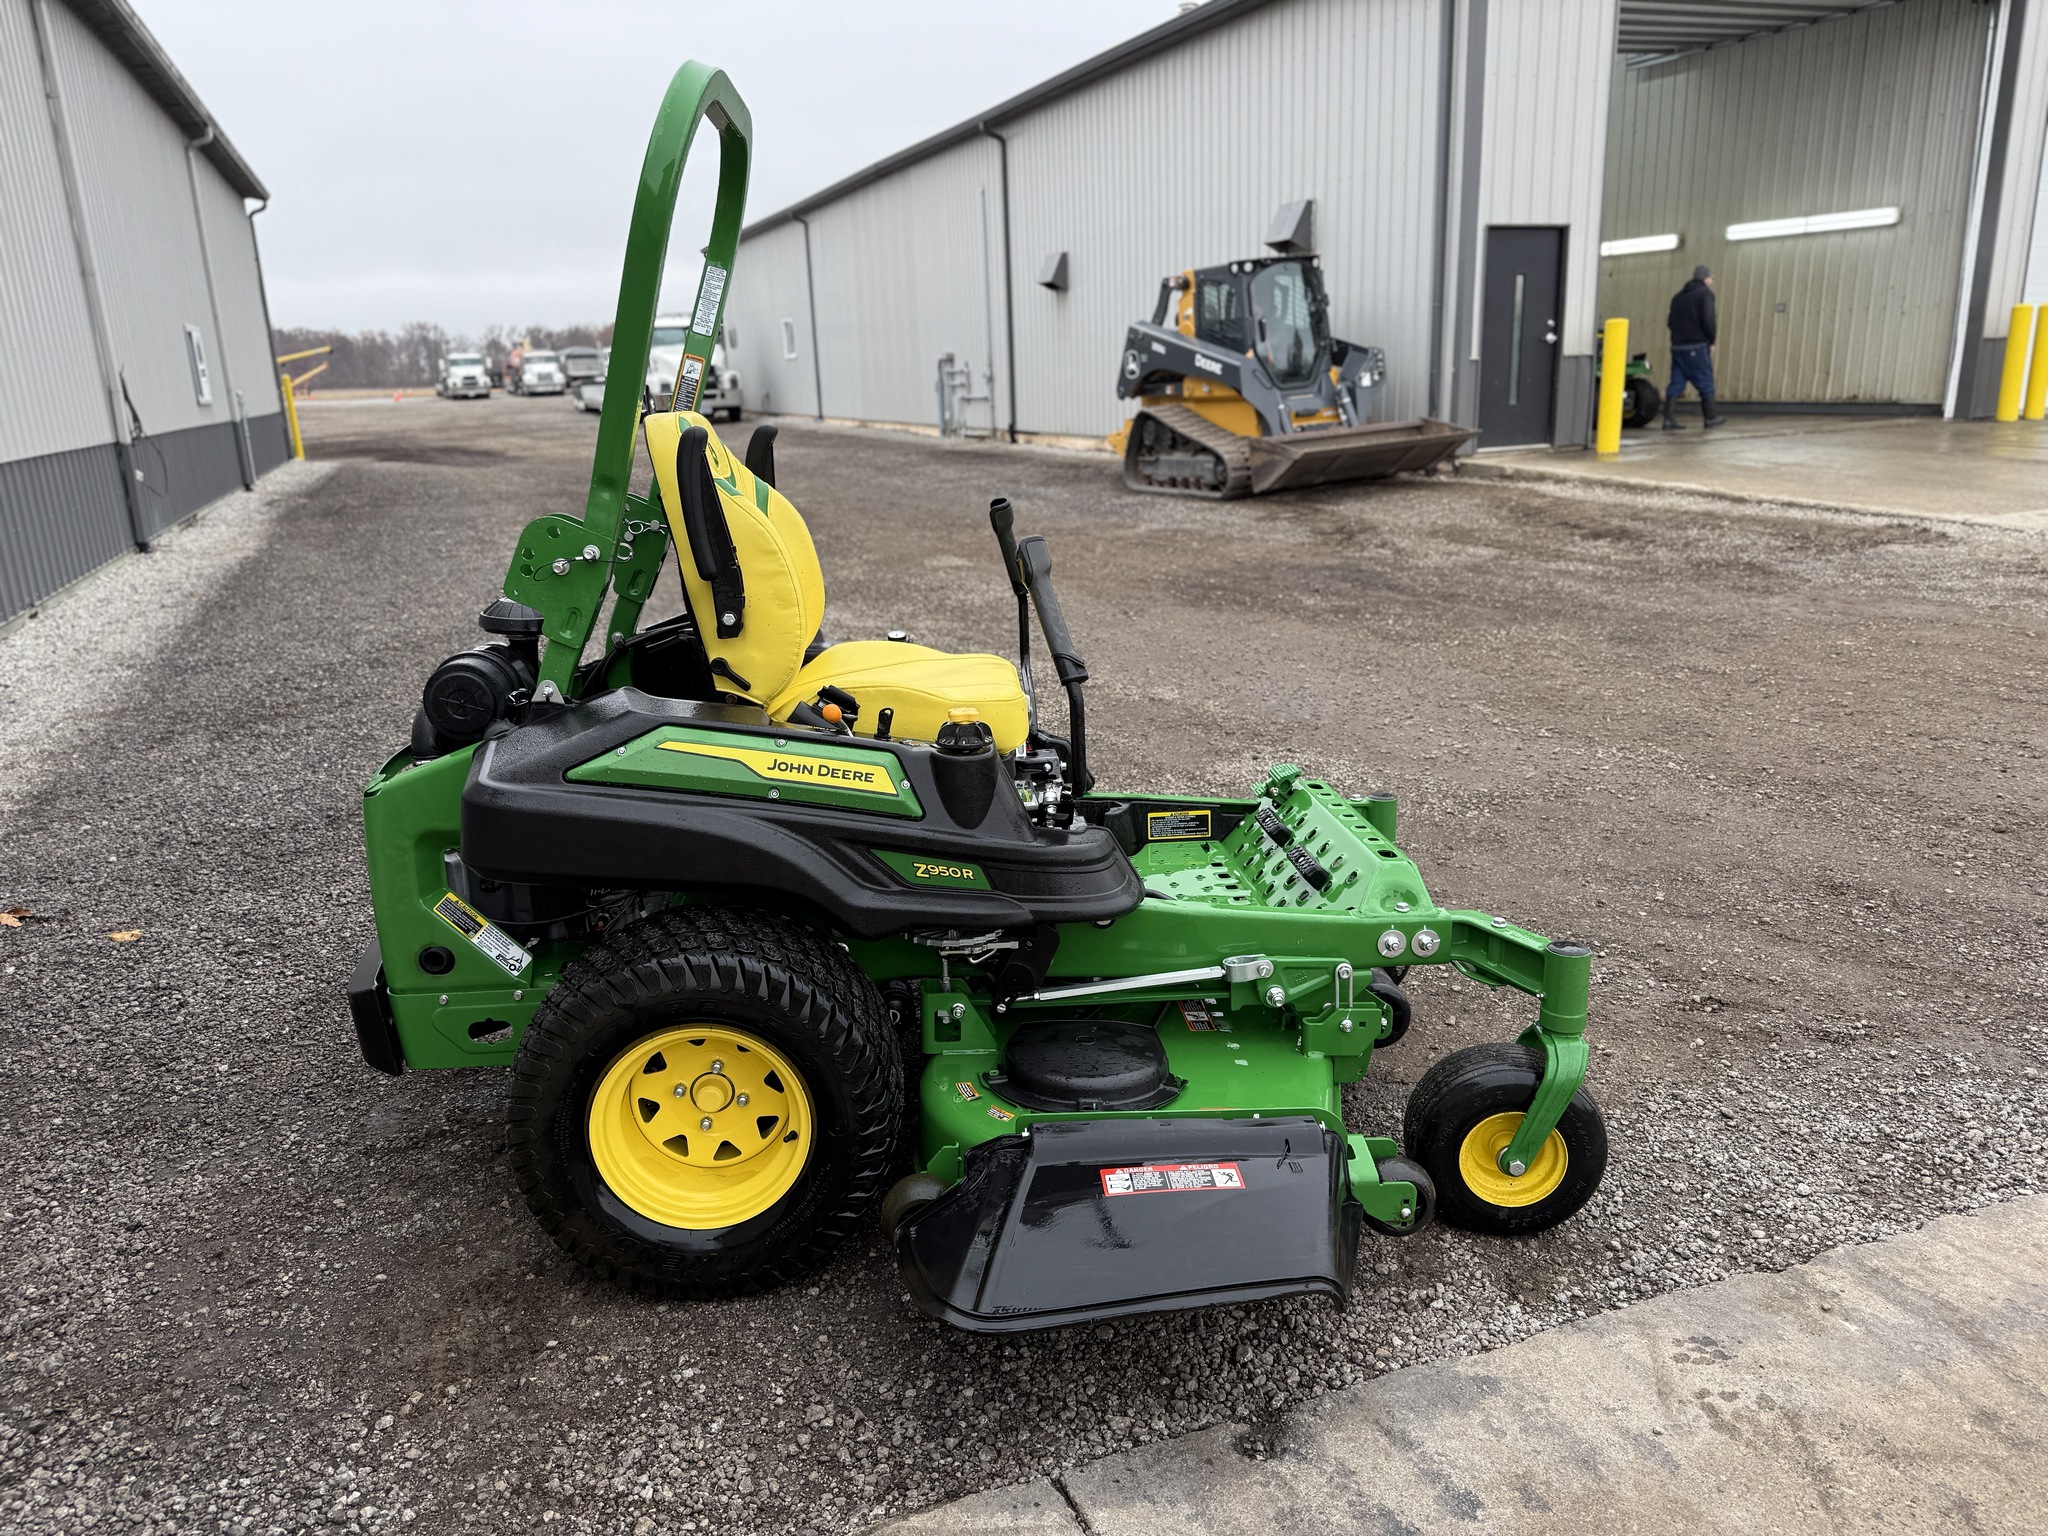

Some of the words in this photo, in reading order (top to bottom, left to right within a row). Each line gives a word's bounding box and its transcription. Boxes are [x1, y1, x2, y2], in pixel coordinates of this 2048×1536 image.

[1195, 353, 1223, 376] DEERE
[767, 757, 813, 775] JOHN
[817, 763, 875, 783] DEERE
[913, 863, 975, 880] Z950R
[459, 902, 480, 919] CAUTION
